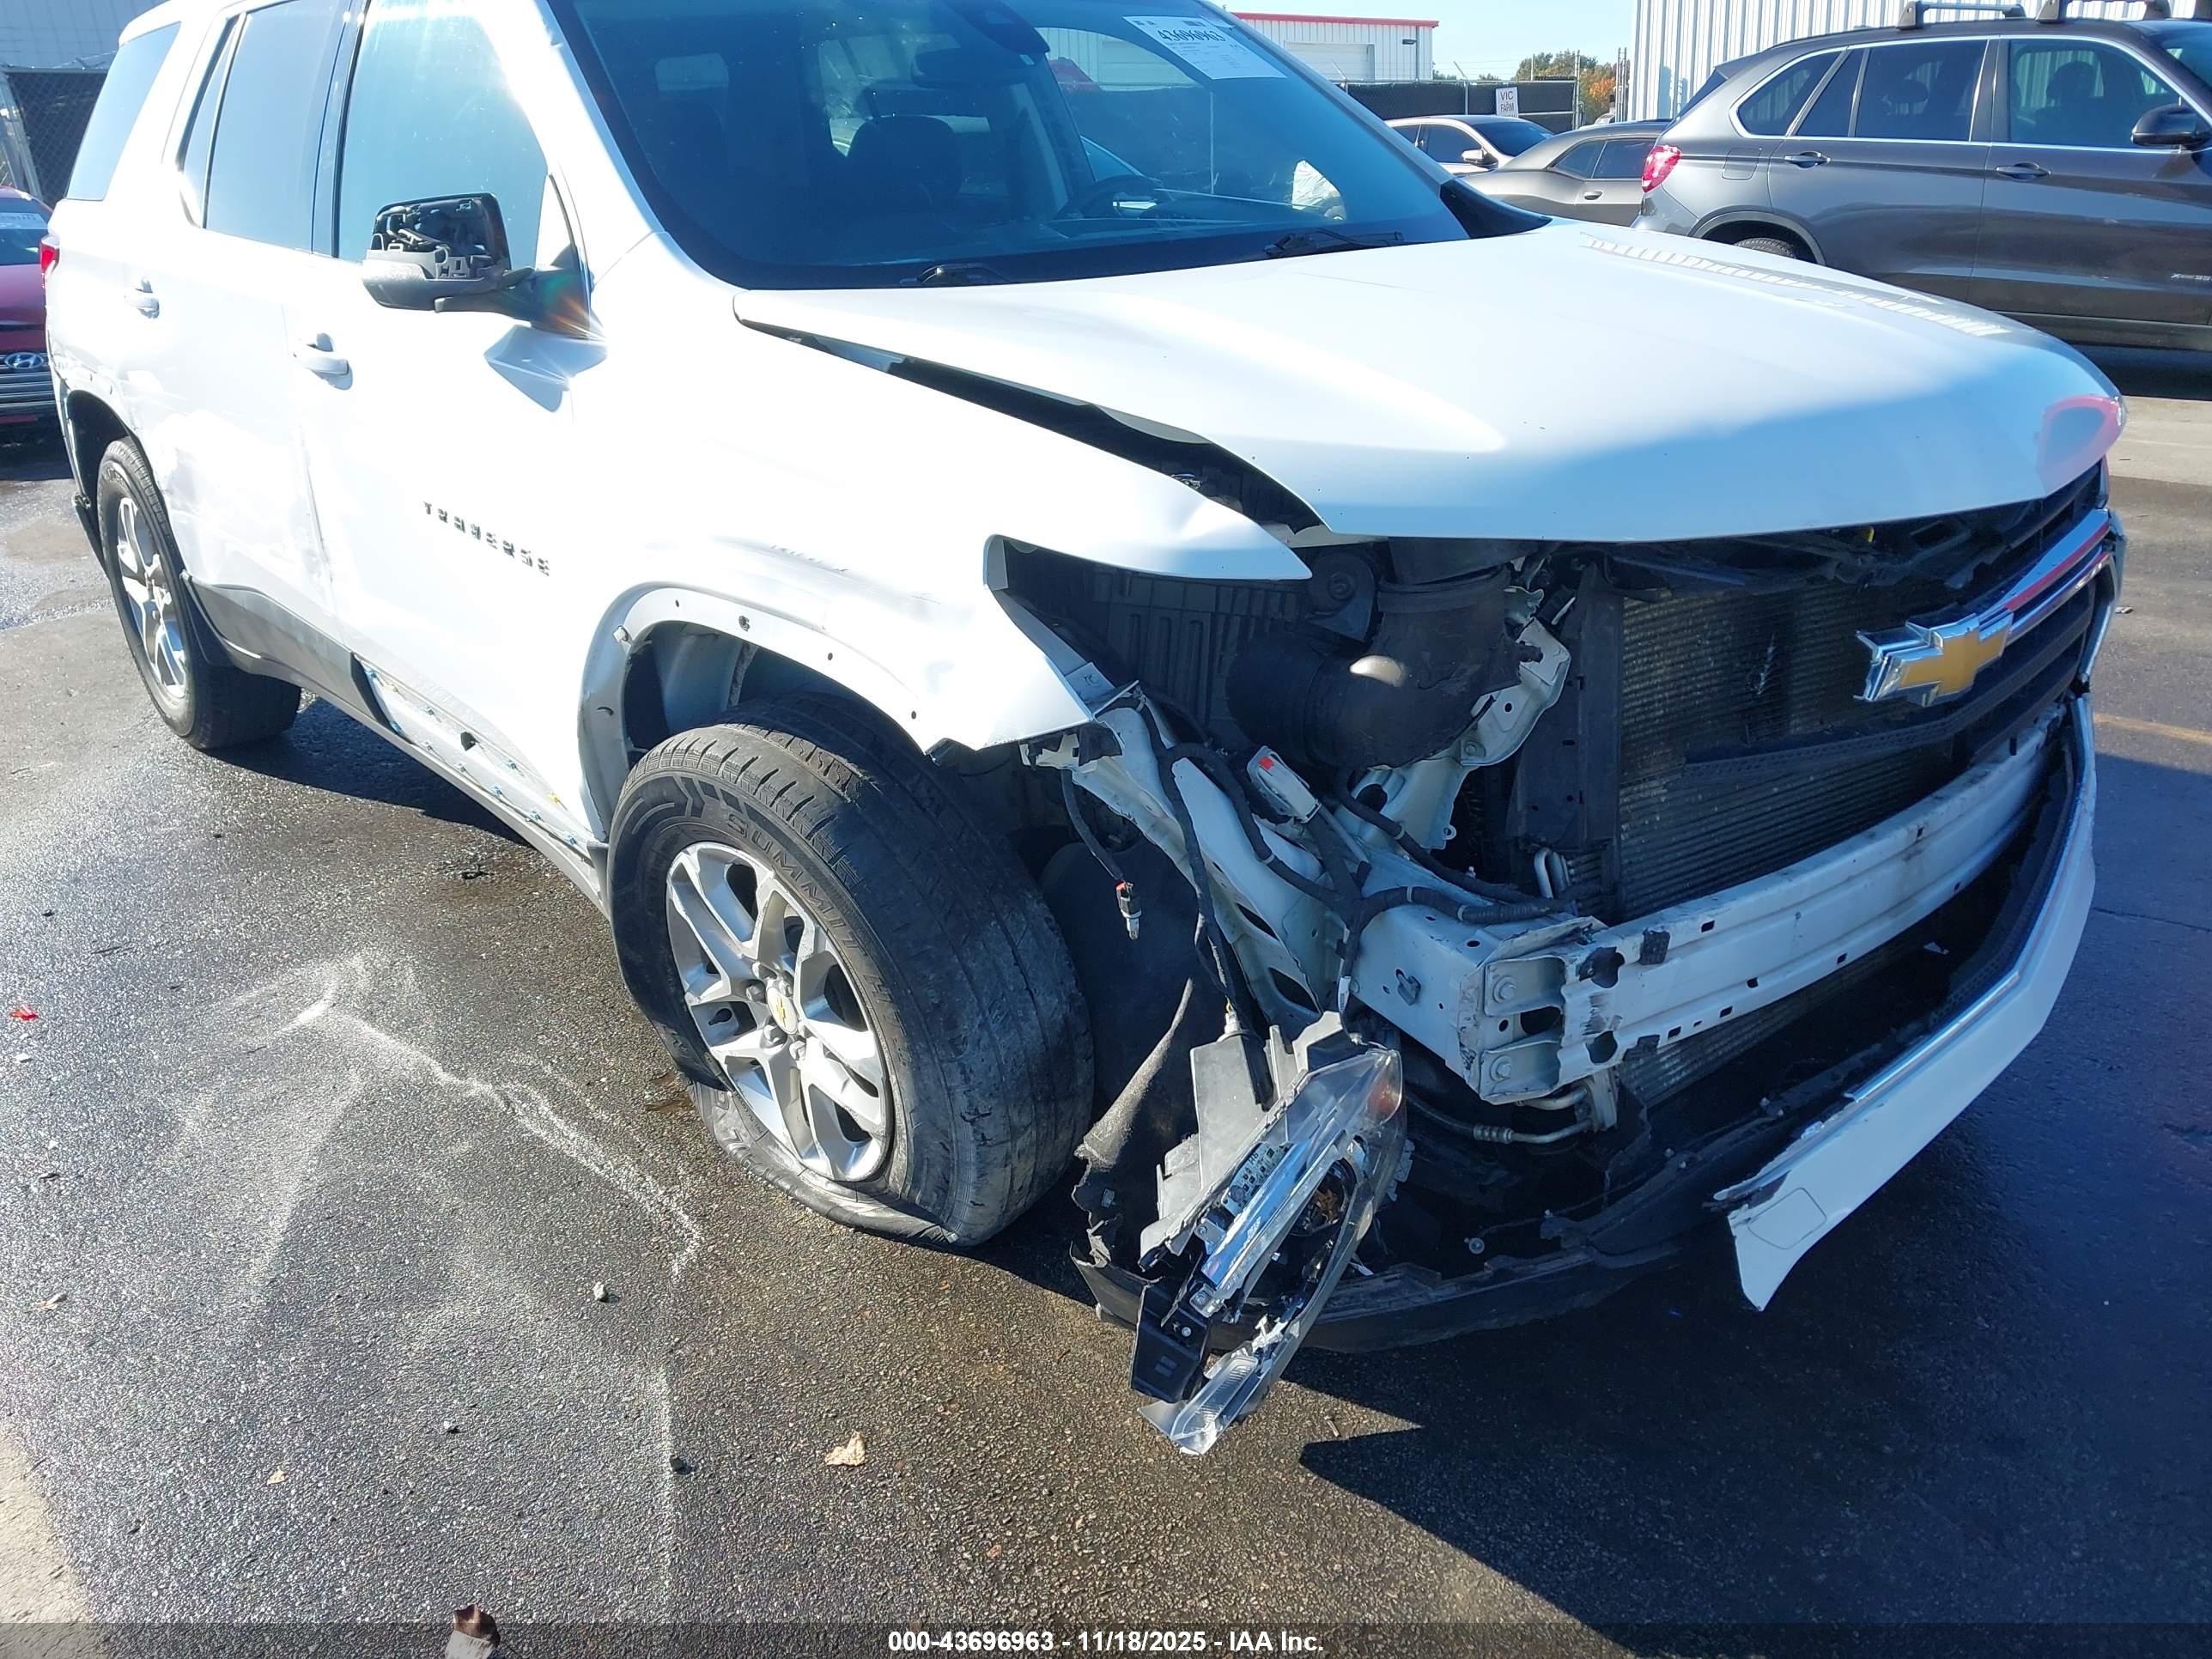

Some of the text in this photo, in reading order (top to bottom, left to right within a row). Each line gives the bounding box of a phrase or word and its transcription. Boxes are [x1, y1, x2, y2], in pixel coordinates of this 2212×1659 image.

[1157, 29, 1226, 42] 43696963
[1500, 90, 1514, 100] VIC
[726, 812, 866, 957] SUMMIT
